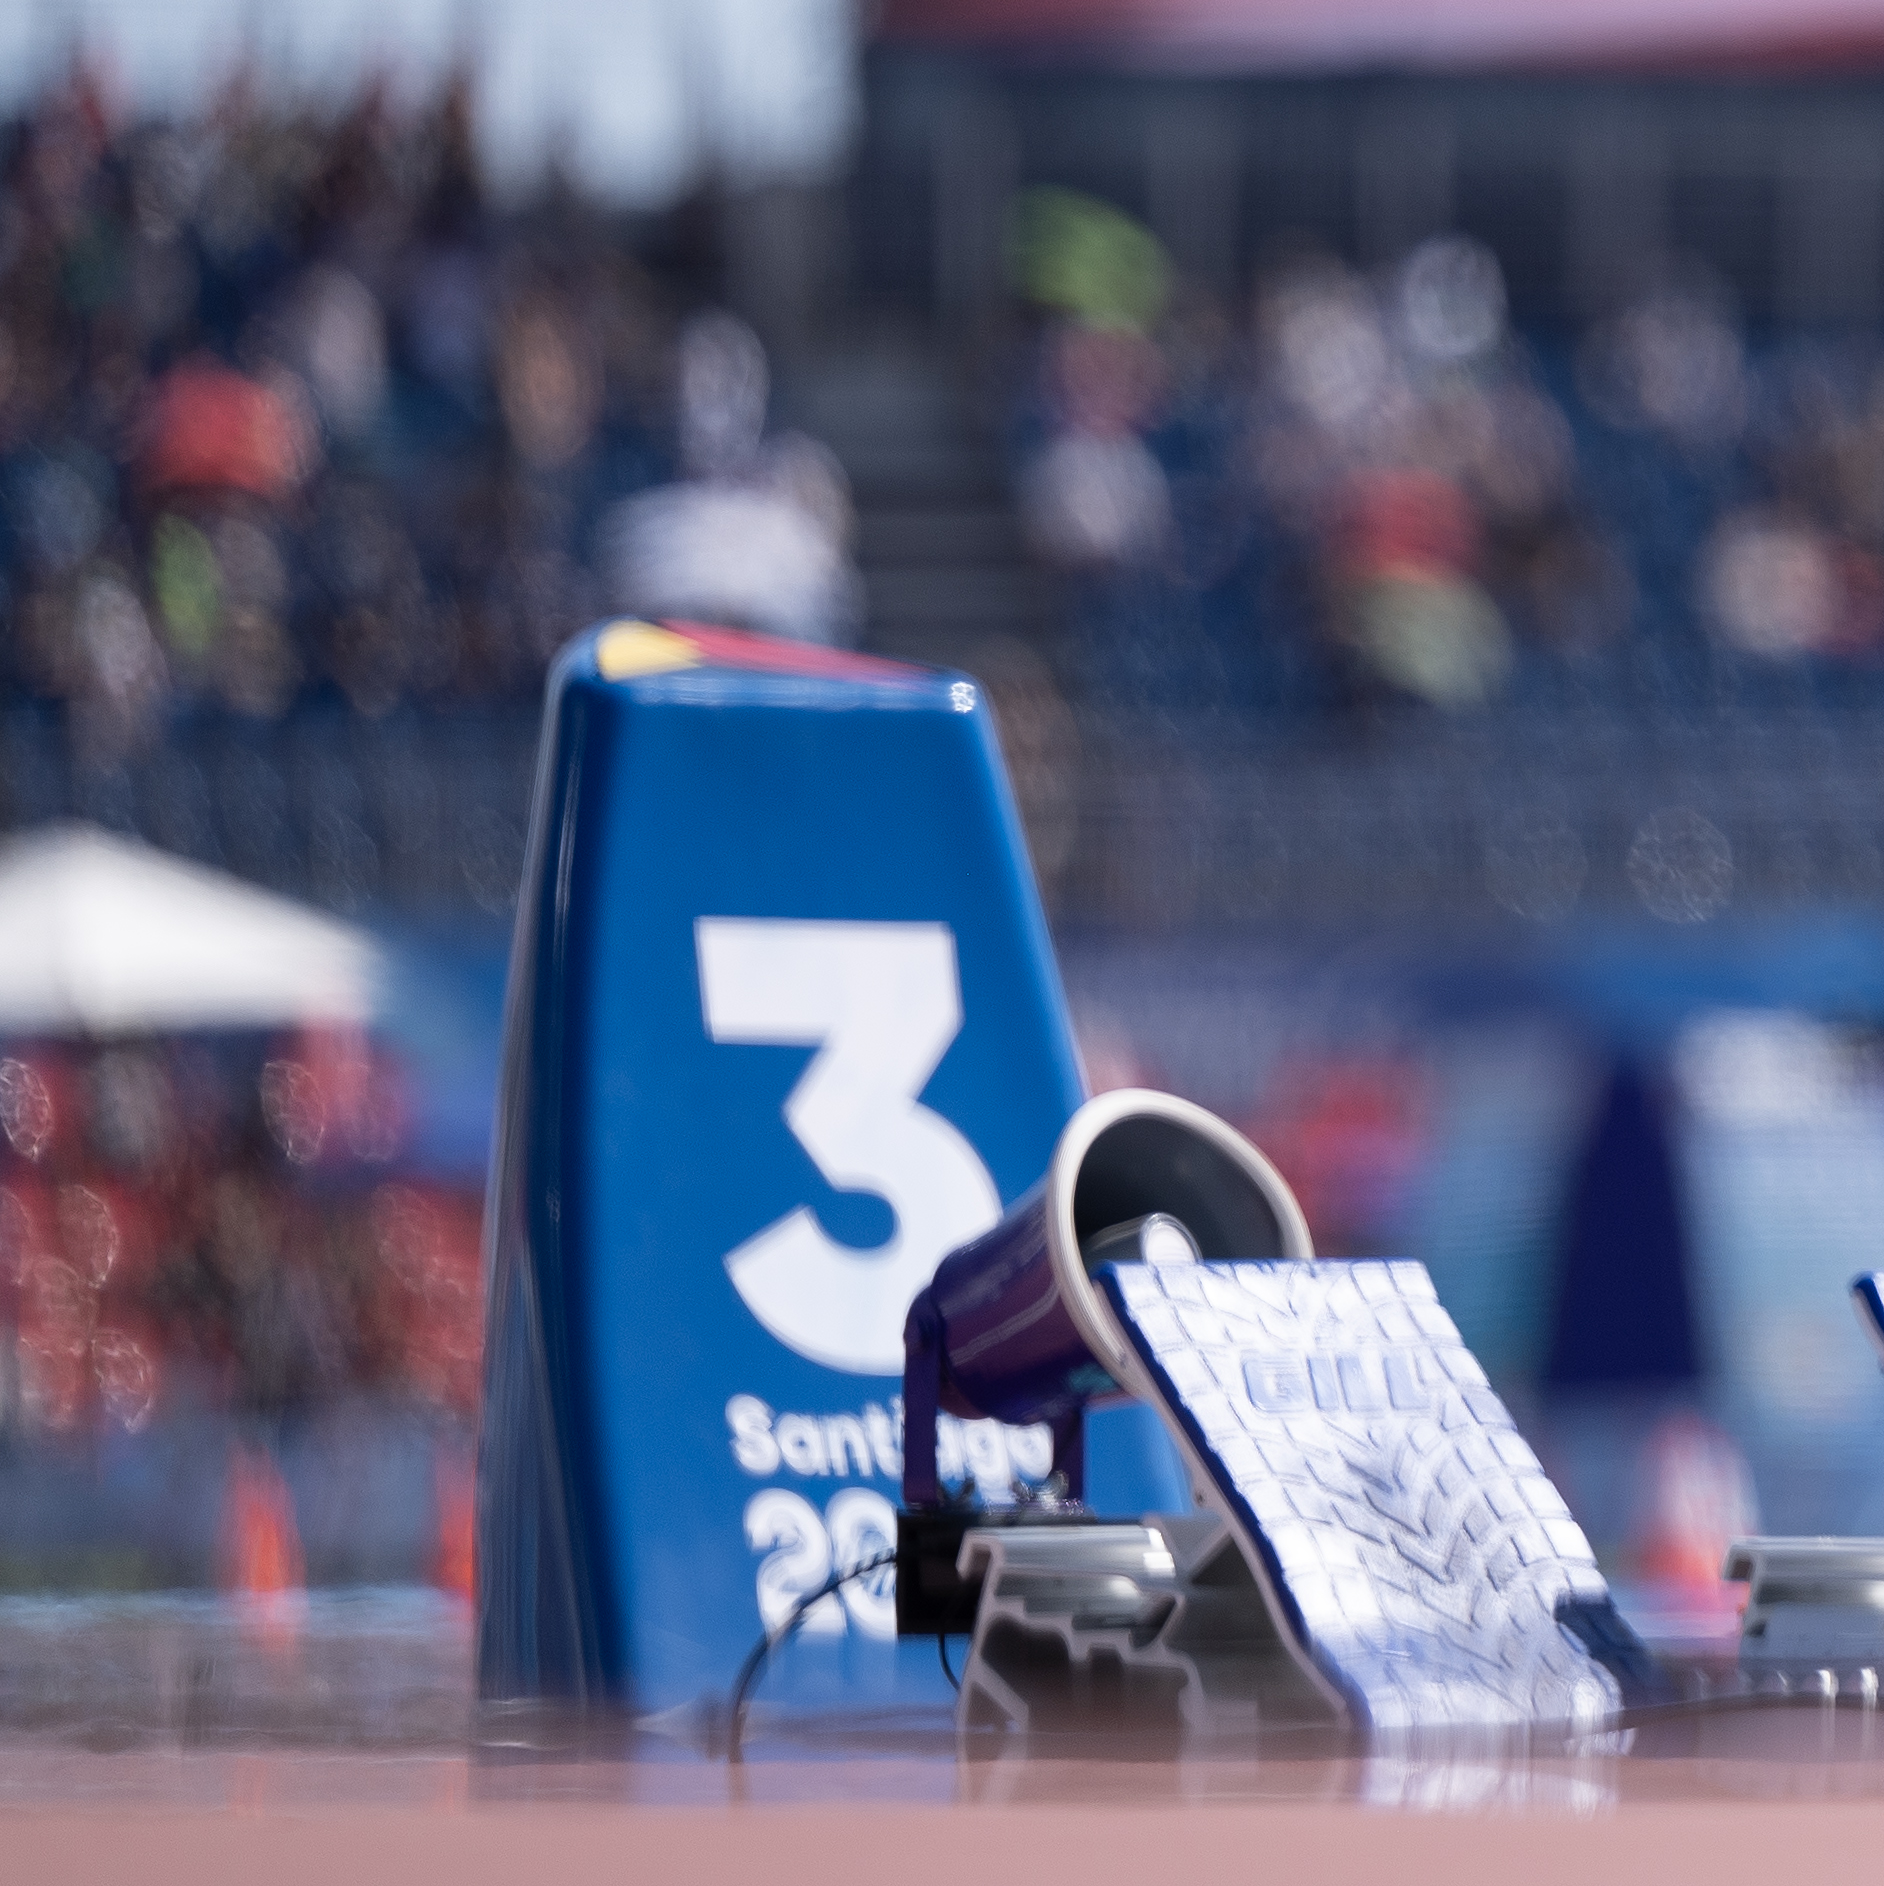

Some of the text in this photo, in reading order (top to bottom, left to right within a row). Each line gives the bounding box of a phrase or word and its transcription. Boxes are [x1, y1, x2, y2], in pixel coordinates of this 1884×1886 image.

[693, 916, 1002, 1377] 3
[1241, 1350, 1433, 1413] GILL
[725, 1393, 1055, 1503] Santago
